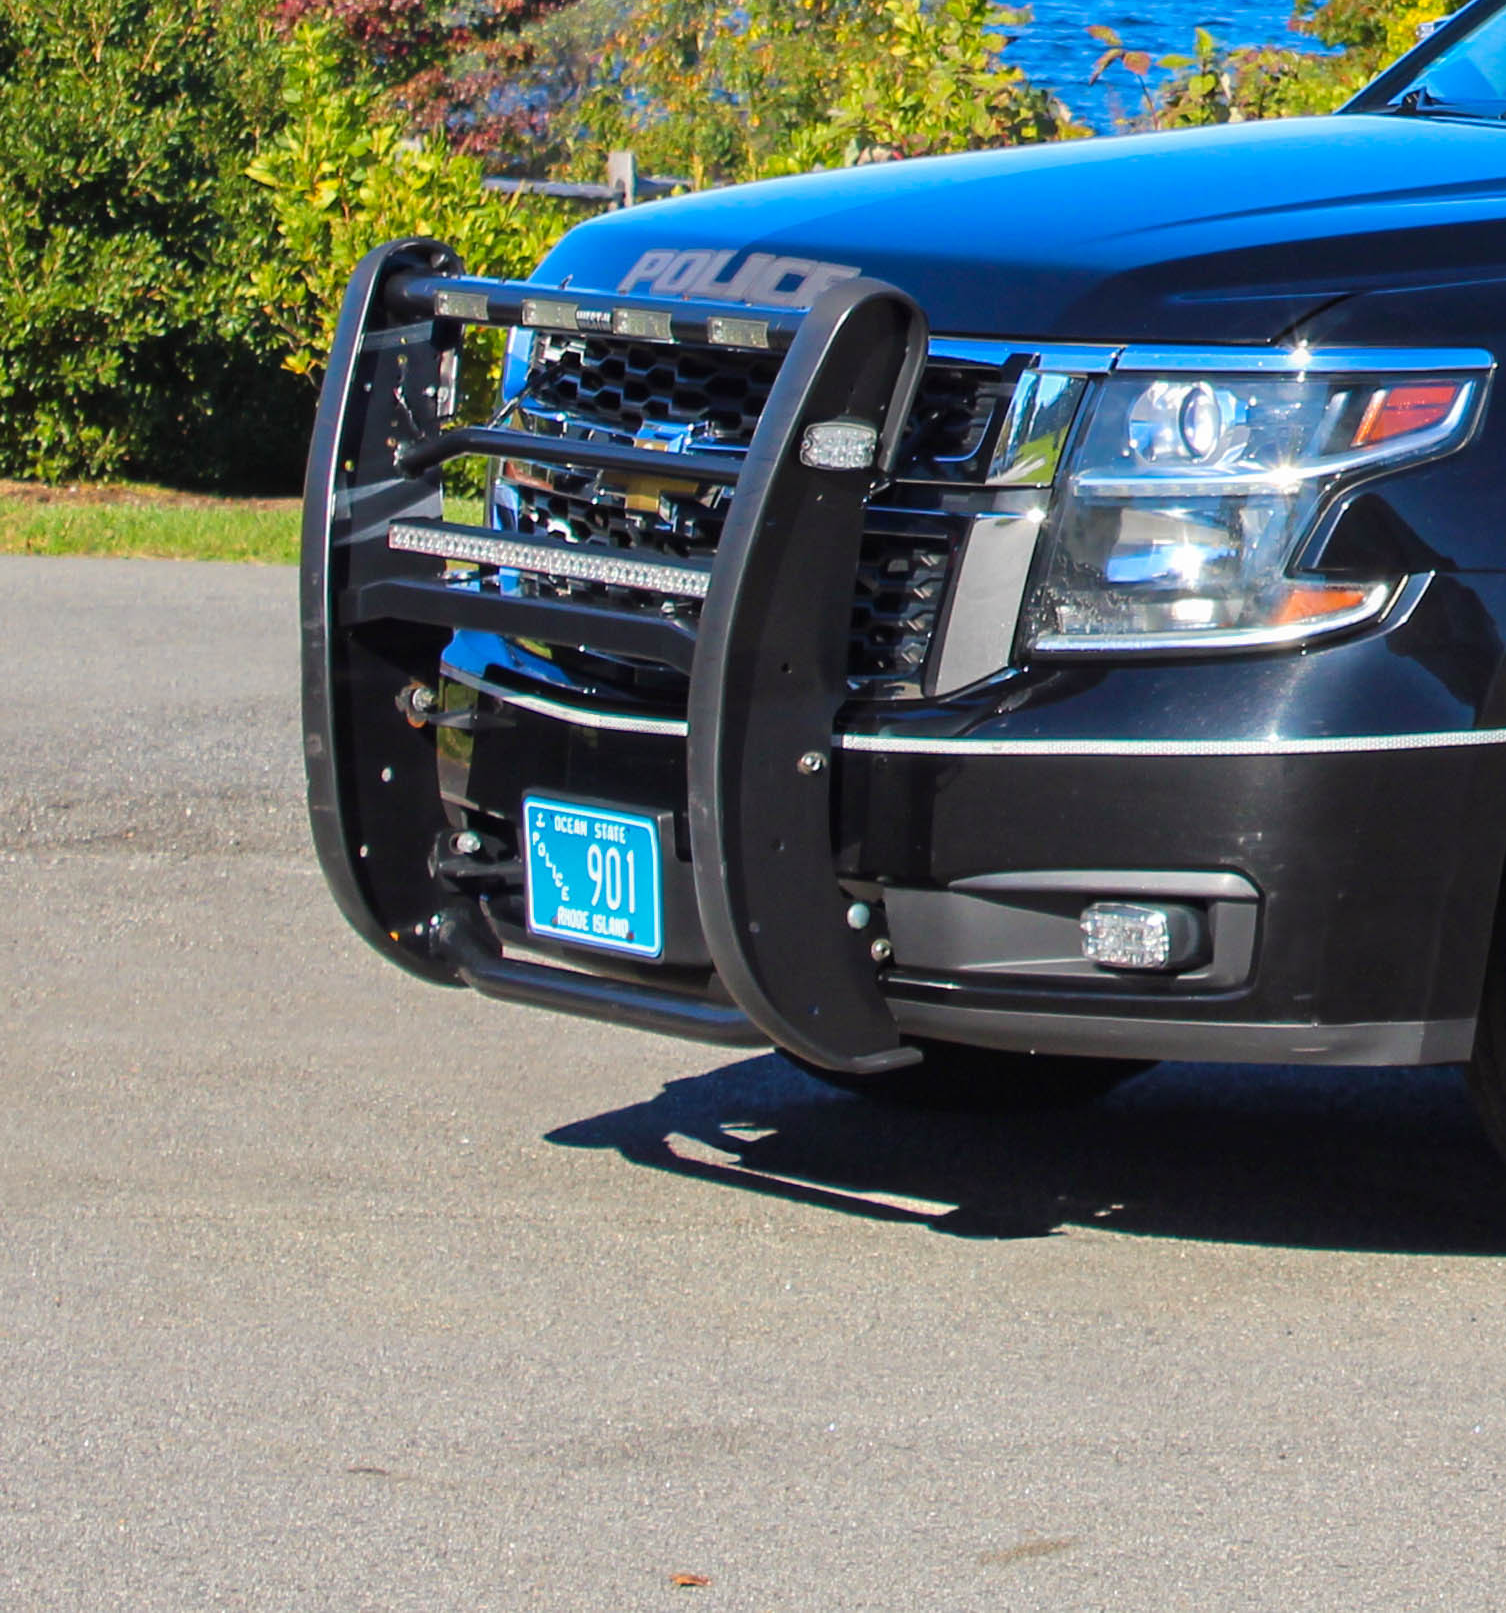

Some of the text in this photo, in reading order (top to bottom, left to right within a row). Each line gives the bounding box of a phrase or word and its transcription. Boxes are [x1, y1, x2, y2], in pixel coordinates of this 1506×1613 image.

[615, 249, 862, 309] POLICE
[554, 815, 626, 844] OCEAN STATE
[532, 831, 570, 902] POLICE
[587, 843, 635, 914] 901
[557, 905, 630, 939] RHODE ISLAND
